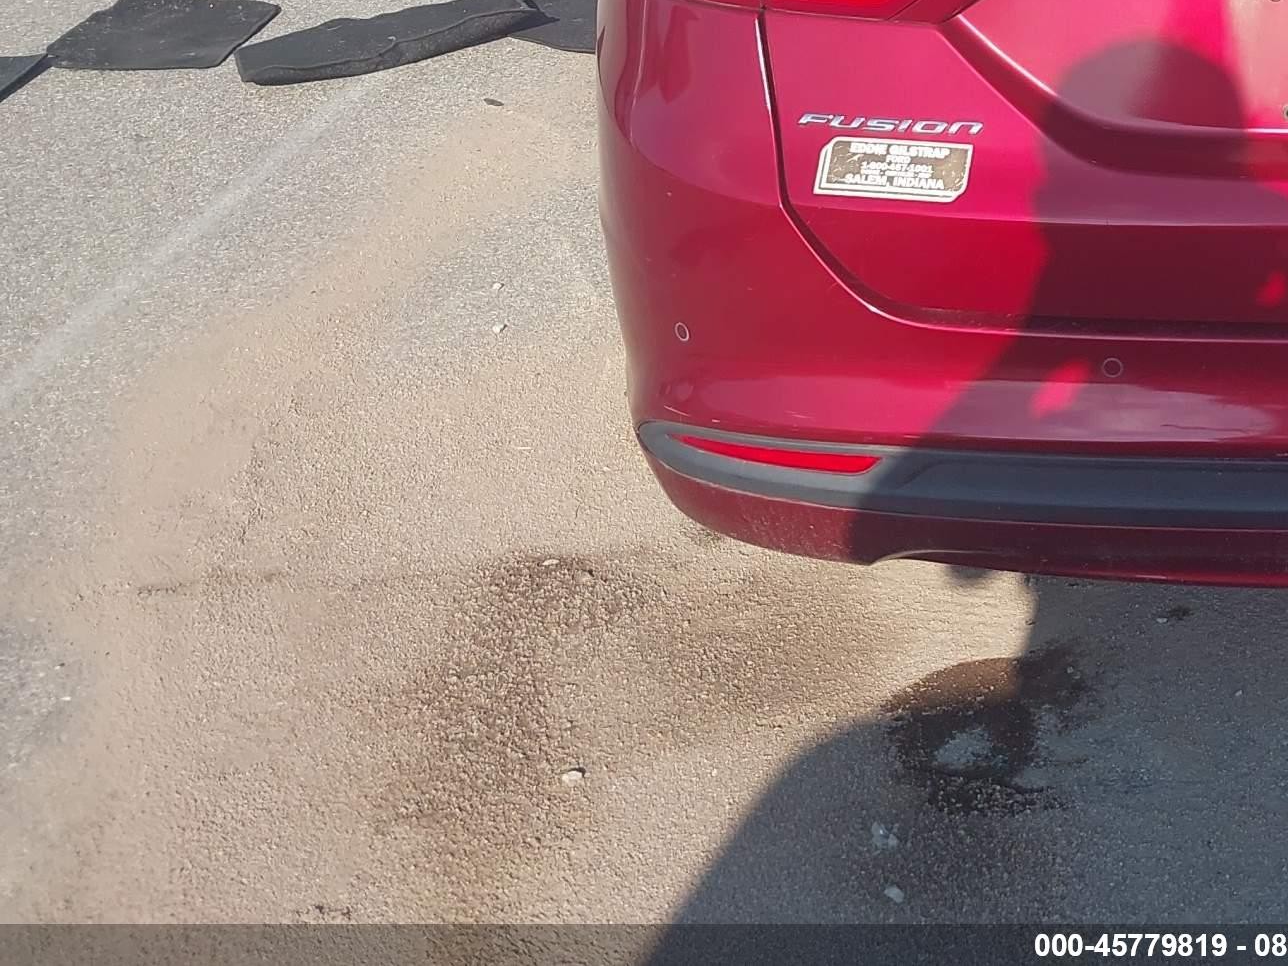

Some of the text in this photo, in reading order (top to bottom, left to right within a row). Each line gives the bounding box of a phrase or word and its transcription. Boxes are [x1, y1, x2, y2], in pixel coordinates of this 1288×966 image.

[798, 113, 984, 135] FUSION
[850, 142, 951, 159] EDDIE GILSTRAP
[886, 155, 911, 164] FORD
[893, 177, 945, 190] INDIANA
